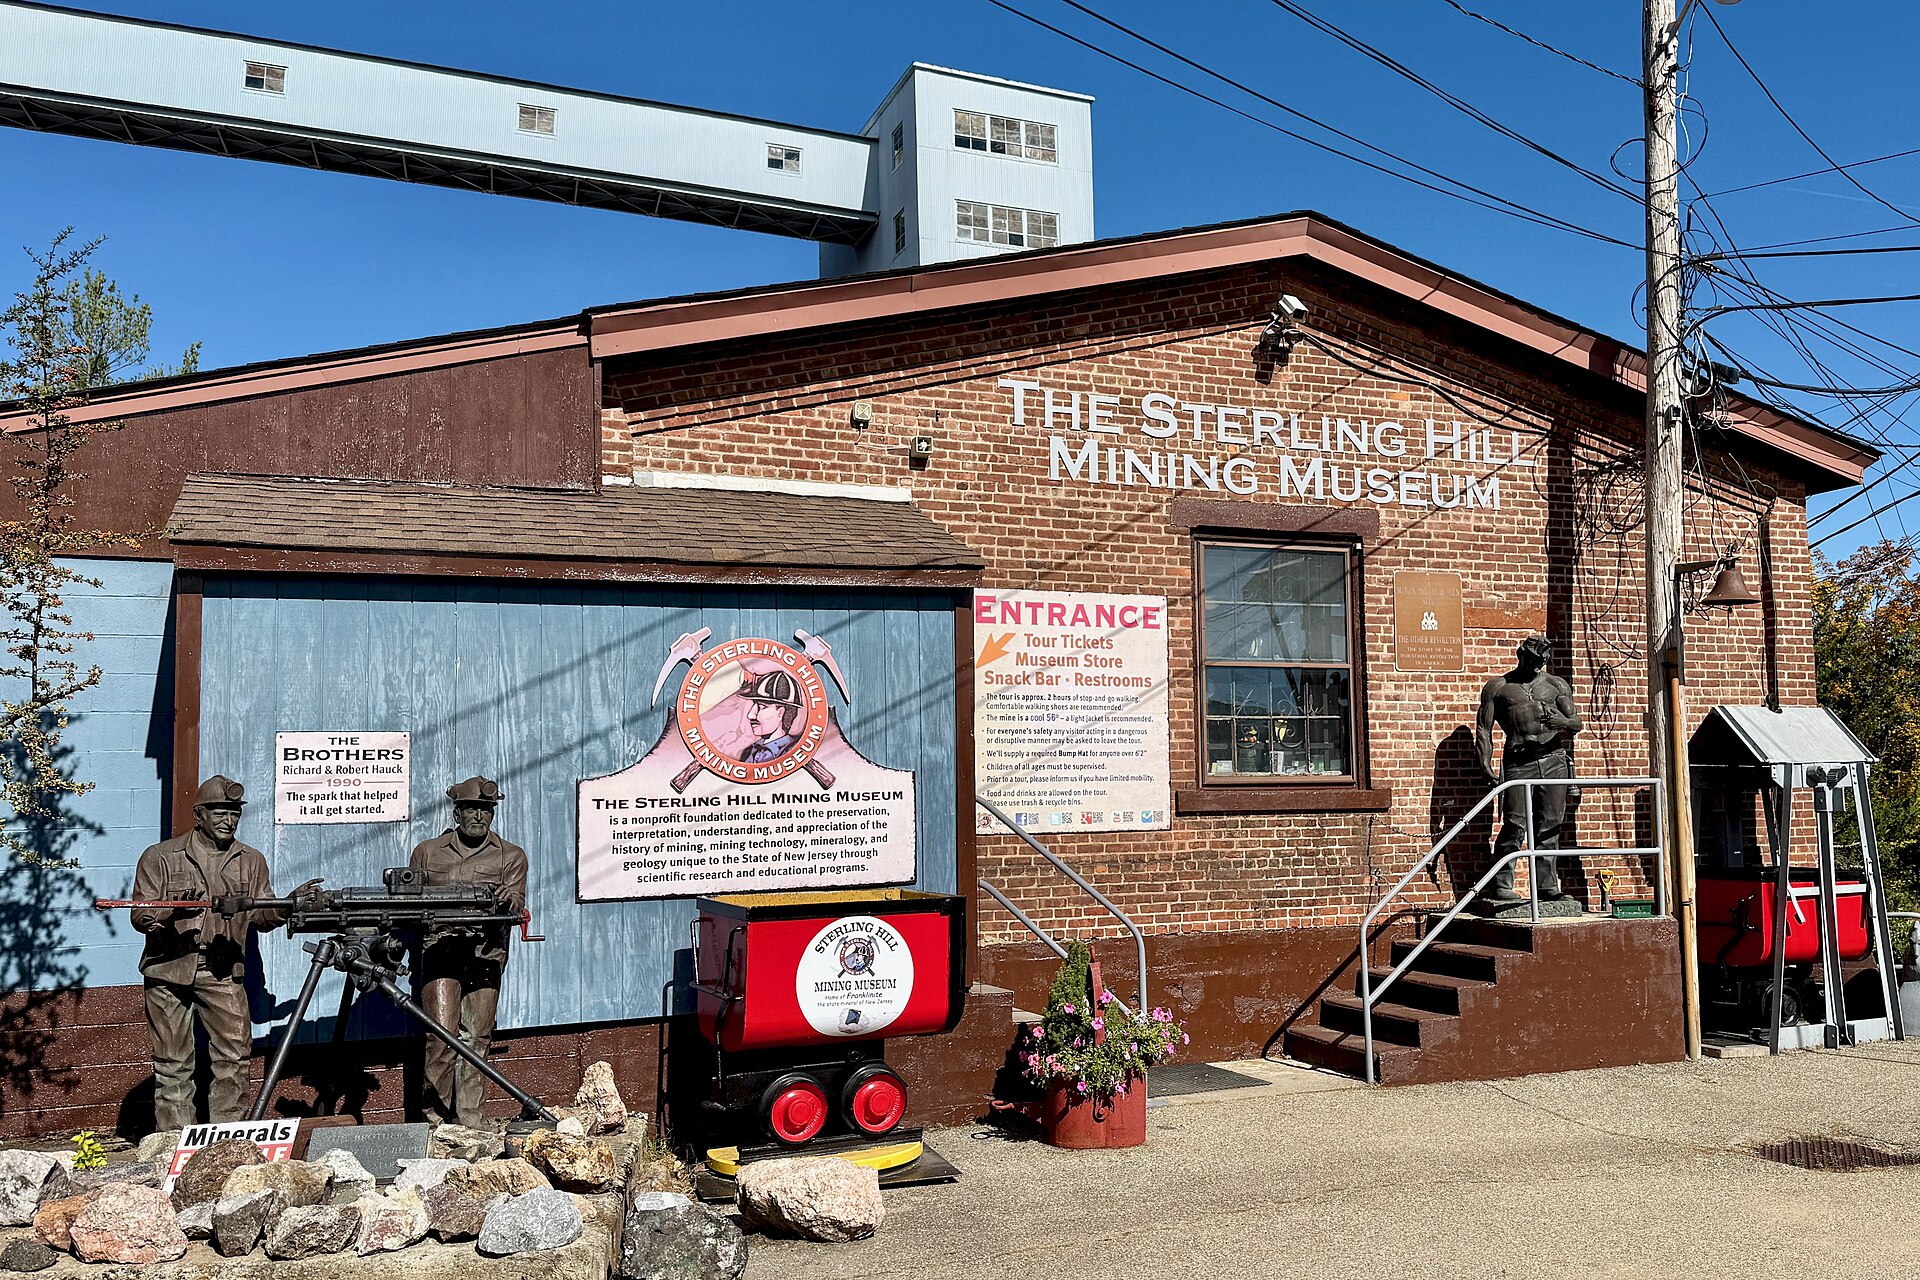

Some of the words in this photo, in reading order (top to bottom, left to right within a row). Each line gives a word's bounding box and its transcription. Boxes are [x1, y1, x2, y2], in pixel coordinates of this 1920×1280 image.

[998, 378, 1121, 434] THE
[1141, 393, 1406, 457] STERLING
[1423, 419, 1535, 467] HILL
[1047, 436, 1259, 495] MINING
[1278, 455, 1501, 510] MUSEUM
[975, 595, 1160, 630] ENTRANCE
[1024, 633, 1057, 648] Tour
[1060, 634, 1113, 650] Tickets
[1015, 652, 1080, 667] Museum
[1083, 653, 1122, 668] Store
[682, 673, 704, 713] THE
[702, 643, 796, 673] STERLING
[797, 665, 823, 709] HILL
[984, 671, 1031, 685] Snack
[1036, 672, 1060, 686] Bar
[1075, 672, 1152, 687] Restrooms
[1022, 694, 1046, 702] approx.
[1024, 703, 1049, 711] walking
[999, 713, 1015, 721] mine
[1030, 713, 1044, 721] cool
[1070, 714, 1084, 723] light
[1085, 714, 1103, 723] jacket
[1086, 728, 1104, 736] acting
[1117, 728, 1147, 736] dangerous
[328, 737, 359, 745] THE
[283, 748, 403, 760] BROTHERS
[686, 727, 747, 779] MINING
[754, 725, 823, 780] MUSEUM
[1003, 750, 1024, 758] supply
[1058, 750, 1076, 758] Bump
[283, 765, 321, 774] Richard
[324, 765, 332, 774] &
[335, 764, 368, 774] Robert
[372, 764, 402, 773] Hauck
[1072, 763, 1106, 771] supervised.
[327, 779, 361, 787] 1990
[1029, 775, 1048, 783] please
[286, 791, 305, 801] The
[308, 791, 337, 802] spark
[340, 791, 360, 800] that
[364, 790, 397, 801] helped
[592, 797, 628, 809] THE
[635, 795, 720, 808] STERLING
[727, 794, 766, 805] HILL
[772, 792, 830, 804] MINING
[836, 789, 902, 801] MUSEUM
[300, 805, 306, 814] it
[310, 805, 323, 814] all
[326, 805, 342, 815] get
[345, 804, 384, 814] started.
[609, 815, 618, 825] is
[631, 812, 680, 826] nonprofit
[683, 811, 739, 822] foundation
[743, 809, 792, 820] dedicated
[795, 809, 804, 818] to
[807, 808, 823, 818] the
[826, 806, 889, 819] preservation,
[612, 827, 690, 841] interpretation,
[694, 824, 772, 838] understanding,
[775, 823, 793, 833] and
[796, 821, 857, 834] appreciation
[860, 820, 869, 829] of
[872, 819, 887, 829] the
[612, 843, 650, 856] history
[653, 842, 664, 852] of
[666, 841, 706, 854] mining,
[710, 839, 746, 852] mining
[748, 837, 807, 850] technology,
[810, 834, 867, 847] mineralogy,
[870, 833, 887, 843] and
[623, 857, 666, 871] geology
[670, 856, 705, 868] unique
[709, 856, 719, 865] to
[722, 854, 739, 864] the
[742, 852, 768, 863] State
[771, 851, 781, 861] of
[784, 851, 805, 861] New
[807, 850, 837, 862] Jersey
[840, 847, 877, 860] through
[637, 871, 685, 883] scientific
[689, 868, 732, 880] research
[736, 867, 754, 877] and
[758, 864, 816, 876] educational
[819, 864, 868, 875] programs.
[815, 922, 874, 954] STERLING
[875, 926, 898, 952] HILL
[814, 980, 851, 992] MINING
[854, 978, 896, 990] MUSEUM
[184, 1122, 291, 1146] Minerals
